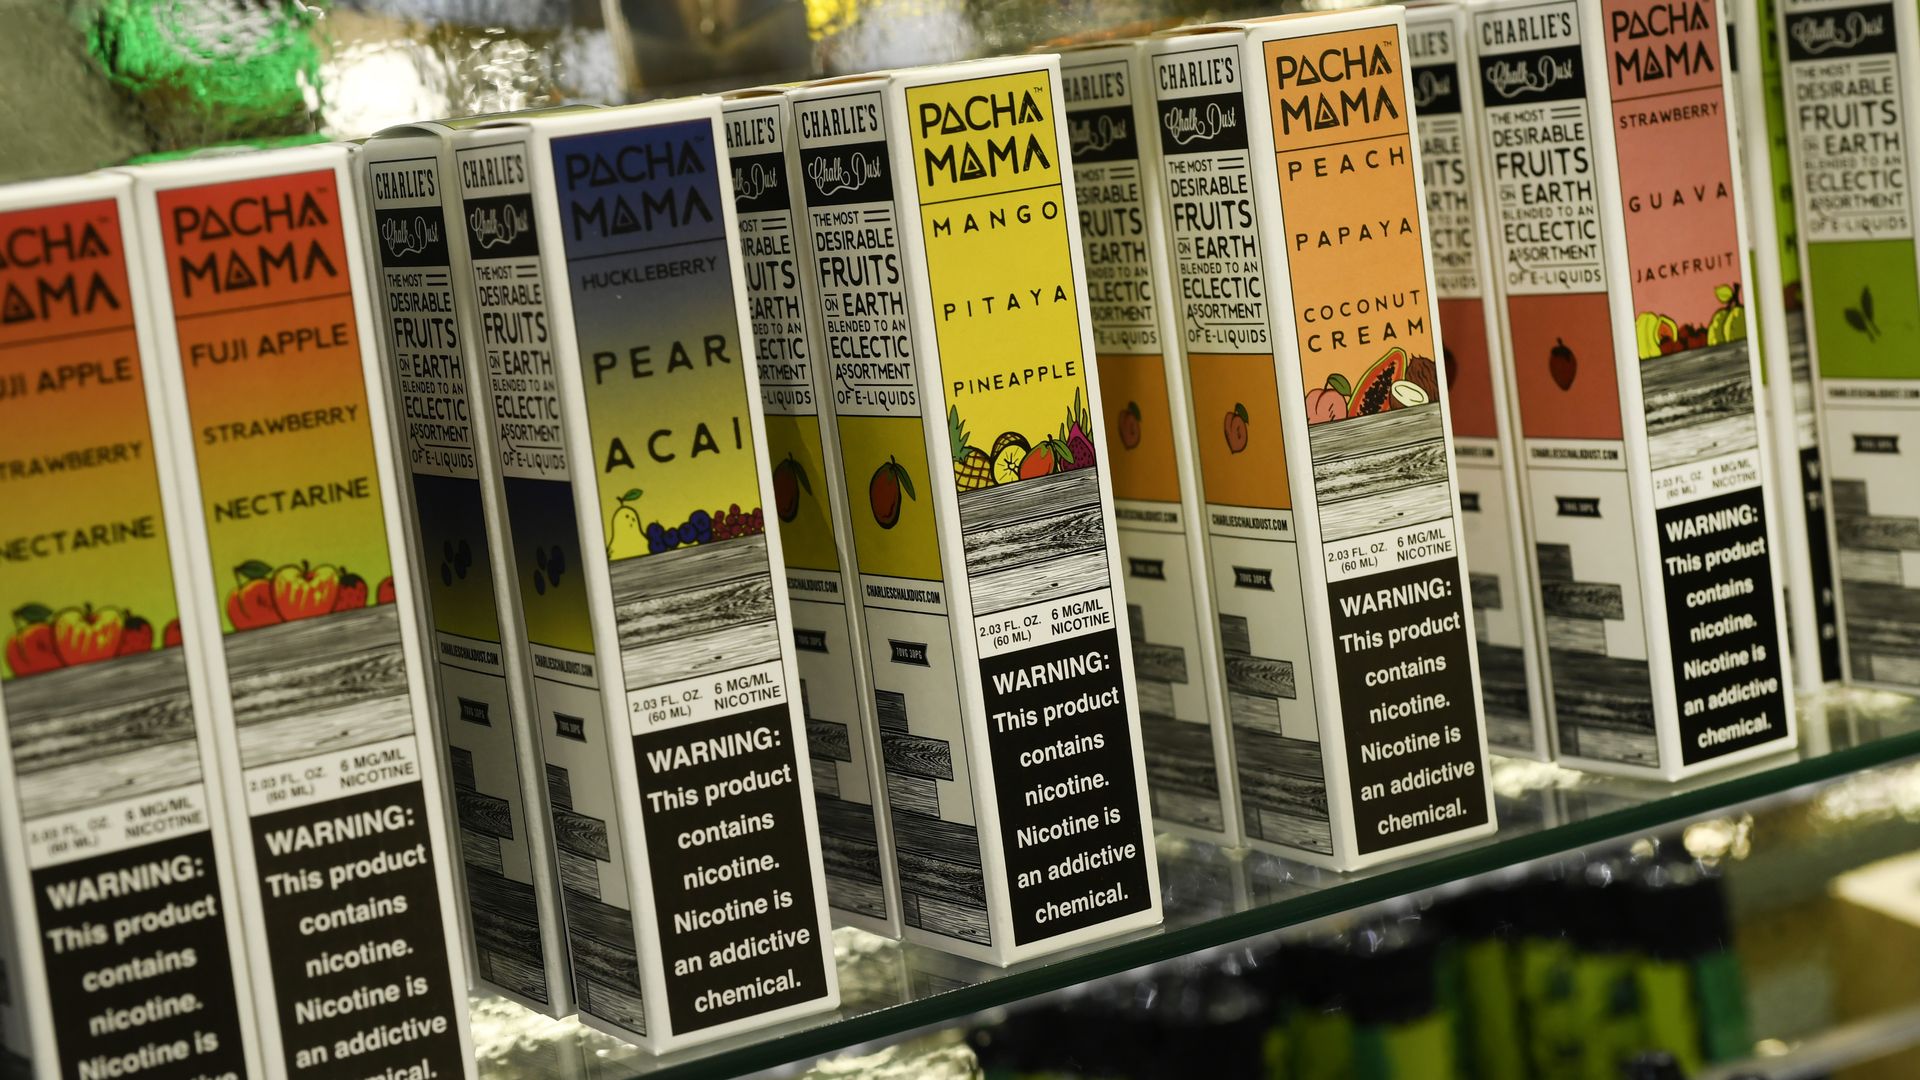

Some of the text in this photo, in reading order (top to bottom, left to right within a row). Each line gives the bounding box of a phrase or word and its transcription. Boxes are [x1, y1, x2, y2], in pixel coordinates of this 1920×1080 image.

[1482, 12, 1572, 46] CHARLIE'S
[1612, 1, 1710, 43] PACHA
[1160, 57, 1234, 91] CHARLIE'S
[1276, 43, 1393, 90] PACHA
[1615, 40, 1714, 86] MAMA
[801, 103, 878, 139] CHARLIE'S
[919, 90, 1044, 139] PACHA
[1280, 85, 1399, 135] MAMA
[1620, 102, 1719, 129] STRAWBERRY
[1799, 99, 1897, 130] FRUITS
[1492, 123, 1585, 148] DESIRABLE
[1824, 132, 1900, 156] EARTH
[462, 154, 524, 189] CHARLIE'S
[565, 139, 705, 191] PACHA
[924, 133, 1051, 187] MAMA
[1169, 159, 1213, 174] THE MOST
[1288, 146, 1404, 181] PEACH
[1495, 147, 1589, 180] FRUITS
[375, 168, 436, 200] CHARLIE'S
[1171, 174, 1248, 198] DESIRABLE
[1522, 180, 1593, 205] EARTH
[1629, 182, 1728, 213] GUAVA
[1806, 169, 1903, 193] ECLECTIC
[172, 191, 329, 246] PACHA
[571, 186, 714, 241] MAMA
[813, 211, 859, 227] THE MOST
[932, 201, 1058, 238] MANGO
[1173, 199, 1252, 231] FRUITS
[815, 228, 894, 251] DESIRABLE
[1178, 235, 1257, 259] ON EARTH
[1296, 217, 1412, 251] PAPAYA
[1504, 220, 1597, 244] ECLECTIC
[180, 239, 338, 298] MAMA
[581, 256, 717, 291] HUCKLEBERRY
[819, 254, 899, 287] FRUITS
[1180, 261, 1258, 275] BLENDED TO AN
[1636, 252, 1733, 283] JACKFRUIT
[1, 271, 120, 325] AMA
[390, 292, 451, 312] DESIRABLE
[825, 291, 904, 317] ON EARTH
[943, 285, 1067, 321] PITAYA
[1182, 277, 1261, 299] ECLECTIC
[1187, 303, 1262, 320] ASSORTMENT
[1304, 290, 1420, 322] COCONUT
[393, 317, 457, 349] FRUITS
[483, 311, 548, 344] FRUITS
[828, 319, 906, 333] BLENDED TO AN
[1189, 329, 1267, 349] OF E-LIQUIDS
[1308, 317, 1424, 353] CREAM
[190, 322, 349, 368] FUJI APPLE
[593, 334, 731, 385] PEAR
[830, 335, 909, 359] ECLECTIC
[36, 359, 133, 394] APPLE
[413, 354, 462, 379] EARTH
[504, 350, 553, 375] EARTH
[835, 363, 910, 381] ASSORTMENT
[953, 361, 1076, 397] PINEAPPLE
[405, 396, 468, 421] ECLECTIC
[495, 395, 558, 420] ECLECTIC
[837, 390, 916, 411] OF E-LIQUIDS
[202, 404, 359, 445] STRAWBERRY
[0, 440, 142, 482] TRAWBERRY
[605, 417, 742, 473] ACAI
[213, 477, 370, 522] NECTARINE
[1212, 514, 1288, 531] CHARLIESCHALKDUST.COM
[1397, 528, 1446, 548] 6 MG/ML
[1665, 504, 1758, 542] WARNING:
[1328, 542, 1387, 562] 2.03 FL. OZ.
[1341, 557, 1378, 574] (60 ML)
[1397, 540, 1452, 562] NICOTINE
[1665, 536, 1766, 576] This product
[866, 584, 941, 604] CHARLIESCHALKDUST.COM
[1051, 599, 1103, 620] 6 MG/ML
[1340, 578, 1452, 618] WARNING:
[1686, 578, 1754, 608] contains
[979, 615, 1042, 637] 2.03 FL. OZ.
[993, 630, 1032, 649] (60 ML)
[1051, 611, 1110, 636] NICOTINE
[1339, 611, 1461, 654] This product
[1690, 613, 1758, 643] nicotine.
[992, 651, 1110, 696] WARNING:
[1365, 655, 1447, 687] contains
[1683, 643, 1766, 680] Nicotine is
[714, 672, 773, 694] 6 MG/ML
[714, 685, 782, 711] NICOTINE
[1684, 677, 1778, 717] an addictive
[633, 689, 703, 713] 2.03 FL. OZ.
[648, 706, 691, 725] (60 ML)
[992, 686, 1120, 733] This product
[1370, 693, 1450, 724] nicotine.
[1360, 725, 1462, 763] Nicotine is
[1698, 712, 1772, 748] chemical.
[647, 727, 781, 774] WARNING:
[1020, 733, 1105, 767] contains
[339, 762, 414, 789] NICOTINE
[647, 763, 792, 813] This product
[1025, 773, 1110, 806] nicotine.
[1361, 761, 1475, 801] an addictive
[265, 805, 415, 856] WARNING:
[678, 812, 775, 849] contains
[1017, 806, 1121, 849] Nicotine is
[1377, 797, 1467, 835] chemical.
[46, 855, 205, 911] WARNING:
[265, 843, 427, 898] This product
[683, 854, 780, 890] nicotine.
[1017, 843, 1136, 889] an addictive
[299, 893, 409, 936] contains
[674, 889, 793, 935] Nicotine is
[1035, 882, 1129, 924] chemical.
[47, 894, 217, 954] This product
[305, 937, 414, 979] nicotine.
[674, 927, 810, 976] an addictive
[82, 947, 198, 992] contains
[295, 974, 429, 1025] Nicotine is
[695, 968, 801, 1013] chemical.
[89, 991, 204, 1037] nicotine.
[78, 1030, 219, 1080] Nicotine is
[295, 1015, 447, 1069] an addictive
